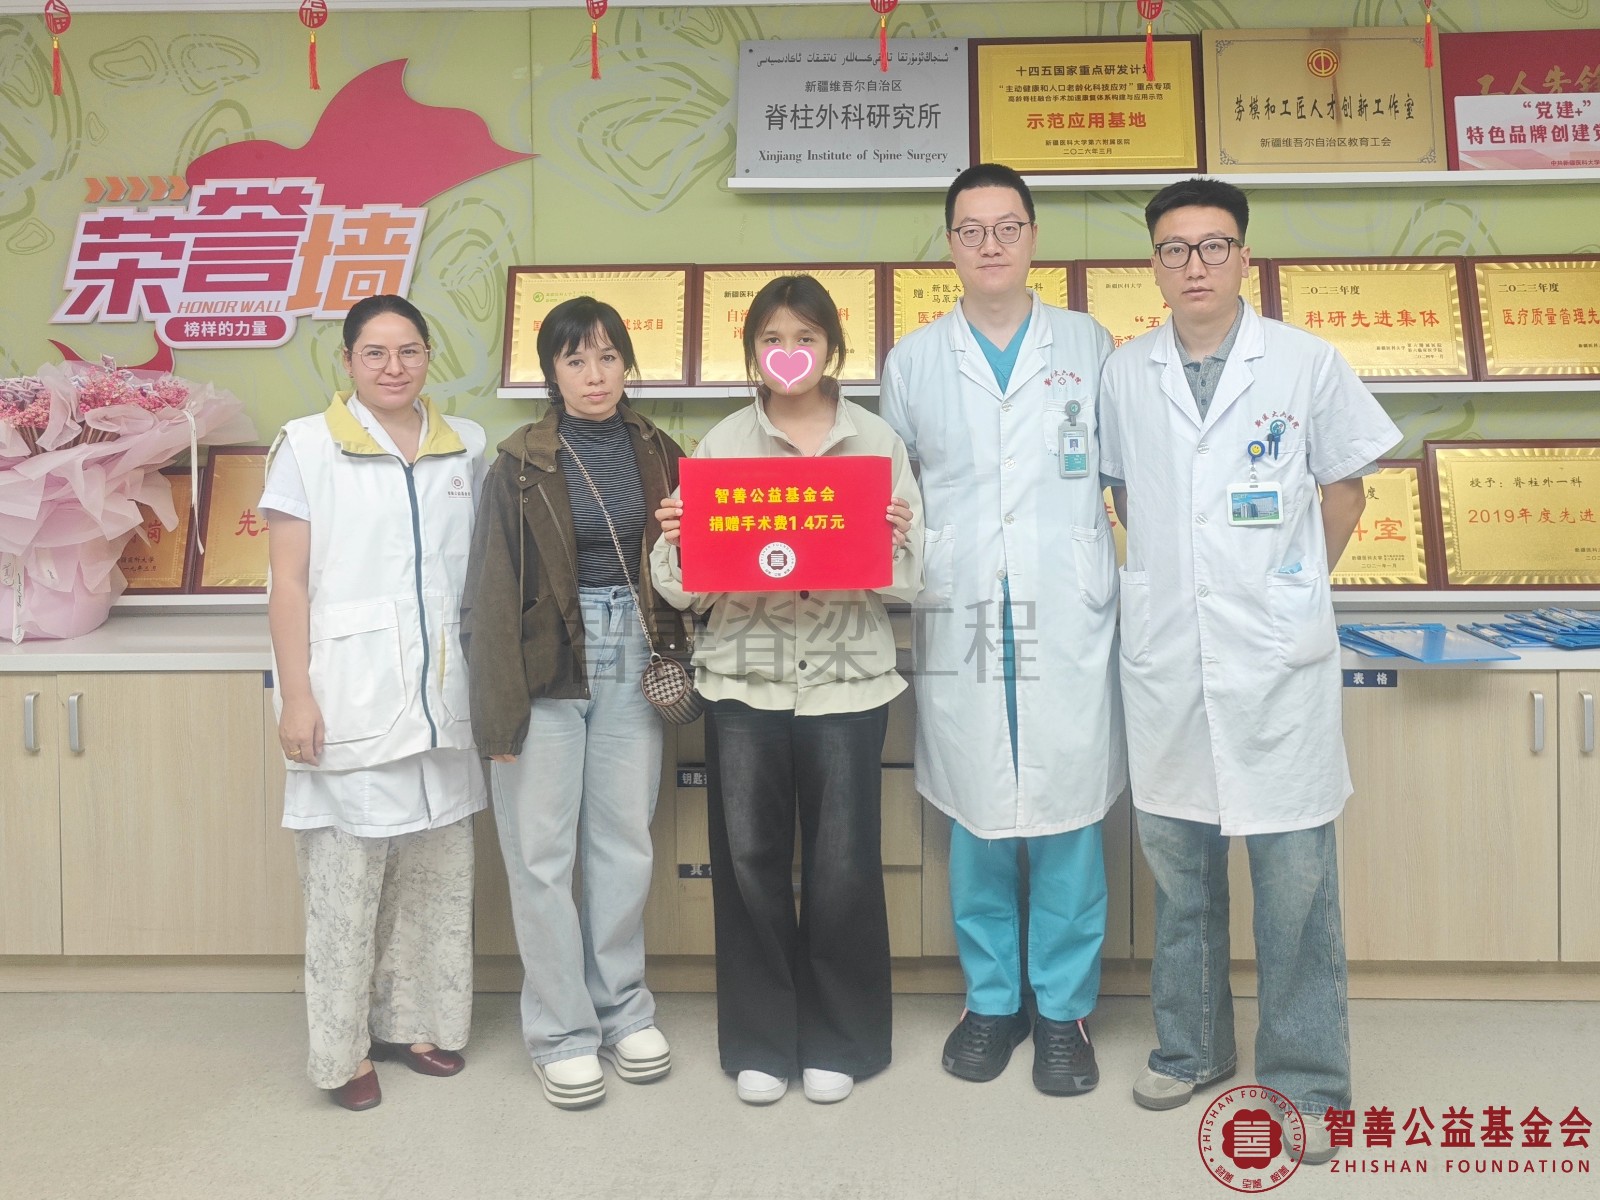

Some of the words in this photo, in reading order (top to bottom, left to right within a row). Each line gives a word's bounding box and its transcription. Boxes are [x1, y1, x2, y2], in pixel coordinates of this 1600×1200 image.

[1016, 64, 1147, 77] 十四五国家重点研发计
[804, 80, 902, 92] 新疆维吾尔自治区
[1234, 93, 1415, 121] 劳模和工匠人才创新工作室
[764, 103, 942, 130] 脊柱外科研究所
[1026, 111, 1147, 130] 示范应用基地
[1045, 138, 1131, 146] 新疆医科大学第六附属医院
[1259, 136, 1392, 149] 新疆维吾尔自治区教育工会
[758, 149, 802, 163] Xinjiang
[807, 149, 852, 161] Institute
[857, 149, 869, 161] of
[873, 149, 902, 163] Spine
[907, 149, 948, 163] Surgery
[66, 184, 414, 315] 荣誉墙
[724, 290, 760, 298] 新疆医科
[931, 284, 964, 293] 新医大
[178, 300, 239, 314] HONOR
[241, 300, 283, 313] WALL
[1305, 308, 1441, 329] 科研先进集体
[183, 319, 268, 338] 榜样的力量
[714, 486, 836, 504] 智善公益基金会
[709, 514, 845, 532] 捐赠手术费1.4万元
[1468, 507, 1597, 525] 2019年度先进
